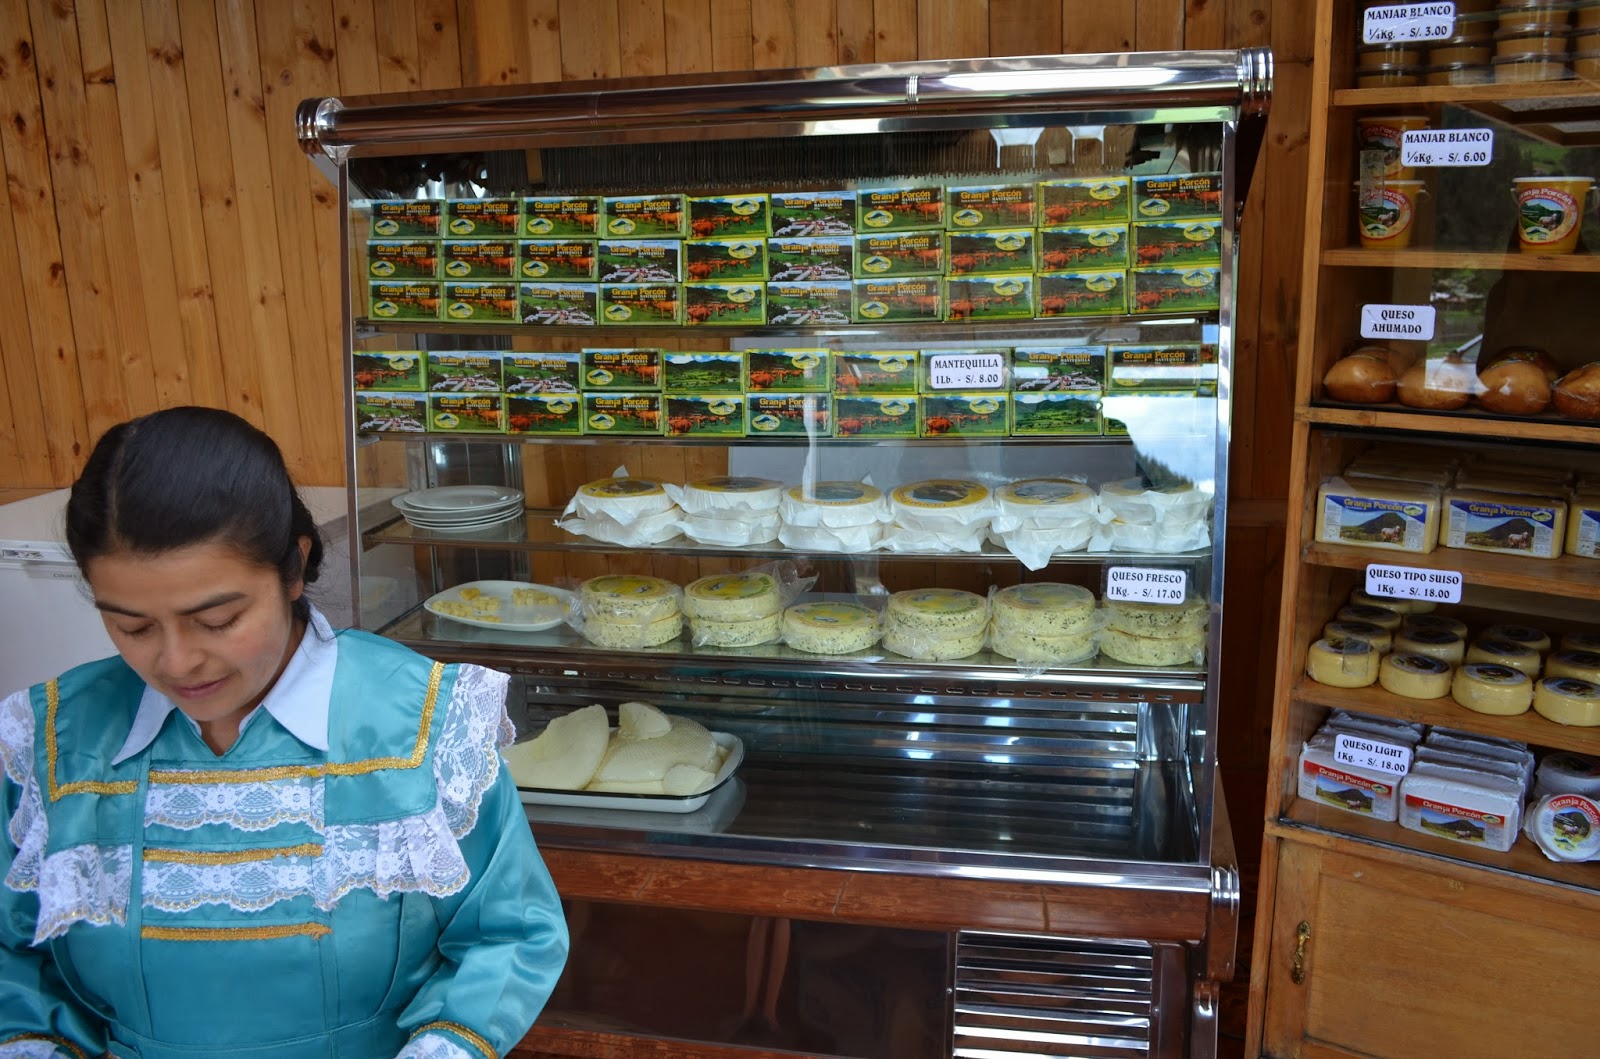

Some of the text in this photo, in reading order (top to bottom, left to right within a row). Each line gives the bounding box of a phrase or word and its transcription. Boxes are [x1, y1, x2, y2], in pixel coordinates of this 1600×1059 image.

[1367, 5, 1450, 20] MANJAR BLANCO
[1410, 28, 1422, 37] S/.
[1425, 26, 1447, 36] 3.00
[1405, 132, 1490, 143] MANJAR BLANCO
[1448, 153, 1460, 162] S/.
[1464, 152, 1486, 161] 6.00
[1147, 180, 1176, 190] Granja
[1179, 178, 1210, 186] Porcón
[871, 192, 899, 202] Granja
[902, 190, 930, 199] Porcón
[961, 192, 989, 202] Granja
[992, 190, 1022, 198] Porcón
[1541, 188, 1571, 204] Porcón
[381, 204, 404, 213] Granja
[407, 203, 430, 211] Porcón
[457, 203, 481, 212] Granja
[535, 202, 559, 212] Granja
[562, 200, 588, 209] Porcón
[616, 201, 641, 211] Granja
[644, 200, 670, 208] Porcón
[784, 198, 811, 209] Granja
[870, 239, 897, 248] Granja
[900, 237, 929, 245] Porcón
[377, 245, 400, 255] Granja
[453, 245, 477, 254] Granja
[479, 244, 504, 252] Porcón
[530, 245, 554, 254] Granja
[611, 246, 636, 256] Granja
[639, 245, 665, 253] Porcón
[782, 243, 808, 253] Granja
[811, 243, 839, 251] Porcón
[380, 286, 403, 296] Granja
[455, 286, 479, 296] Granja
[532, 288, 557, 297] Granja
[612, 288, 638, 299] Granja
[640, 288, 666, 296] Porcón
[780, 287, 807, 297] Granja
[868, 284, 895, 294] Granja
[898, 283, 926, 291] Porcón
[1381, 310, 1414, 320] QUESO
[1372, 324, 1422, 333] AHUMADO
[439, 357, 463, 365] Granja
[594, 353, 648, 363] Granja Porcón
[1029, 352, 1058, 362] Granja
[1123, 352, 1152, 362] Granja
[515, 358, 539, 367] Granja
[935, 359, 998, 368] MANTEQUILLA
[966, 375, 976, 383] S/.
[979, 374, 998, 382] 8.00
[367, 397, 389, 405] Granja
[440, 397, 464, 406] Granja
[596, 398, 621, 408] Granja
[1344, 498, 1403, 510] Granja Porcón
[1469, 504, 1531, 517] Granja Porcón
[1112, 572, 1181, 583] QUESO FRESCO
[1369, 569, 1459, 584] QUESO TIPO SUISO
[1142, 589, 1153, 597] S/.
[1157, 590, 1181, 599] 17.00
[1409, 587, 1420, 596] S/.
[1424, 588, 1450, 598] 18.00
[1342, 739, 1403, 758] QUESO LIGHT
[1367, 757, 1378, 767] S/.
[1381, 760, 1405, 773] 18.00
[1319, 768, 1371, 787] Granja Porcón
[1423, 800, 1480, 819] Granja Porcón
[1552, 797, 1599, 824] Granja Porcón
